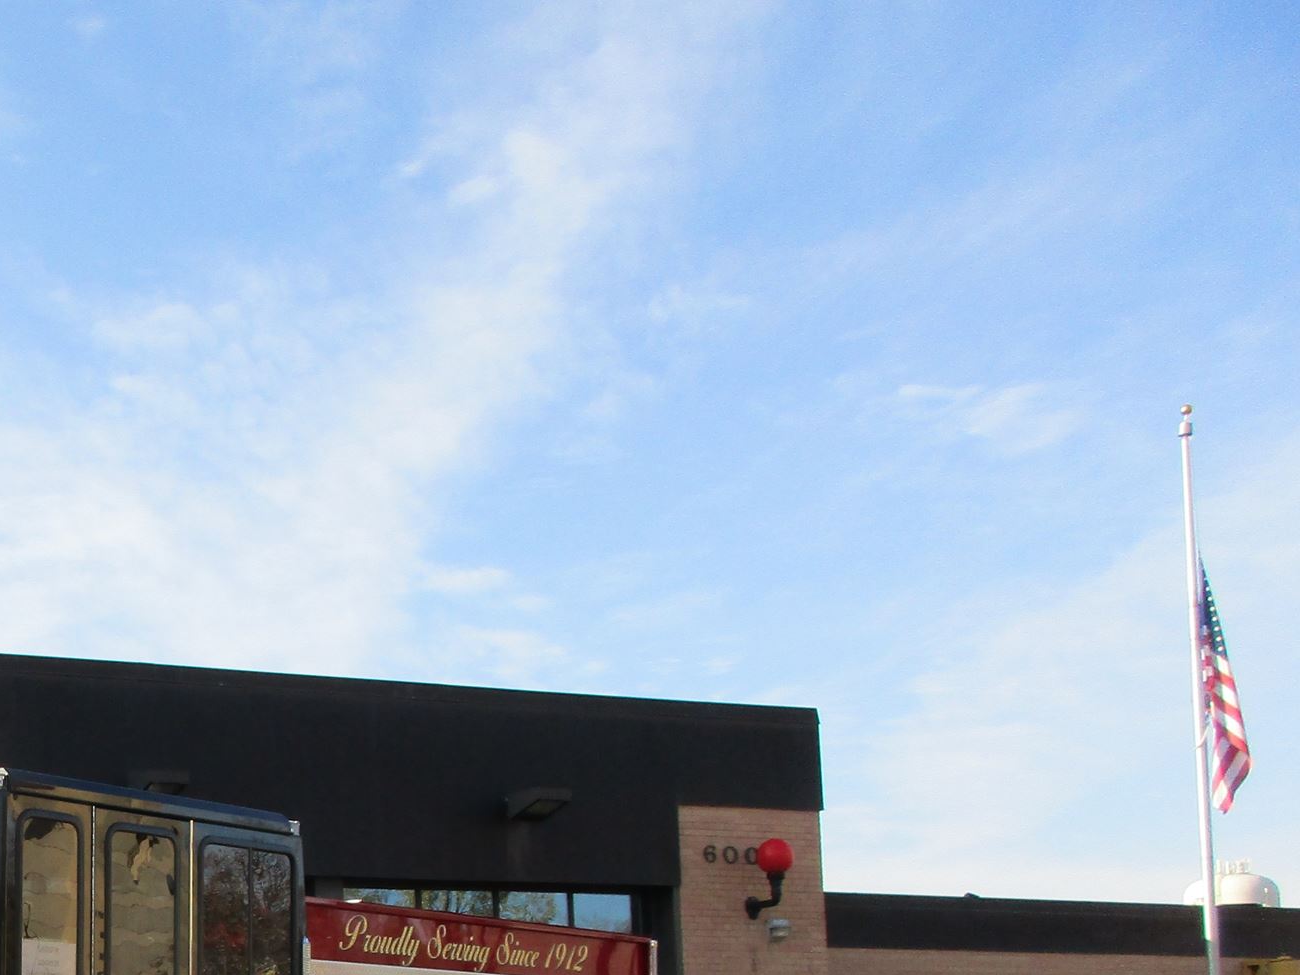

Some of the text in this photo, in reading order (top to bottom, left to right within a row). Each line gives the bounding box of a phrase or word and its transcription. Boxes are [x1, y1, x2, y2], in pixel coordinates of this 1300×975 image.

[703, 845, 758, 865] 600
[339, 914, 589, 973] Proudly Serving Since 1912
